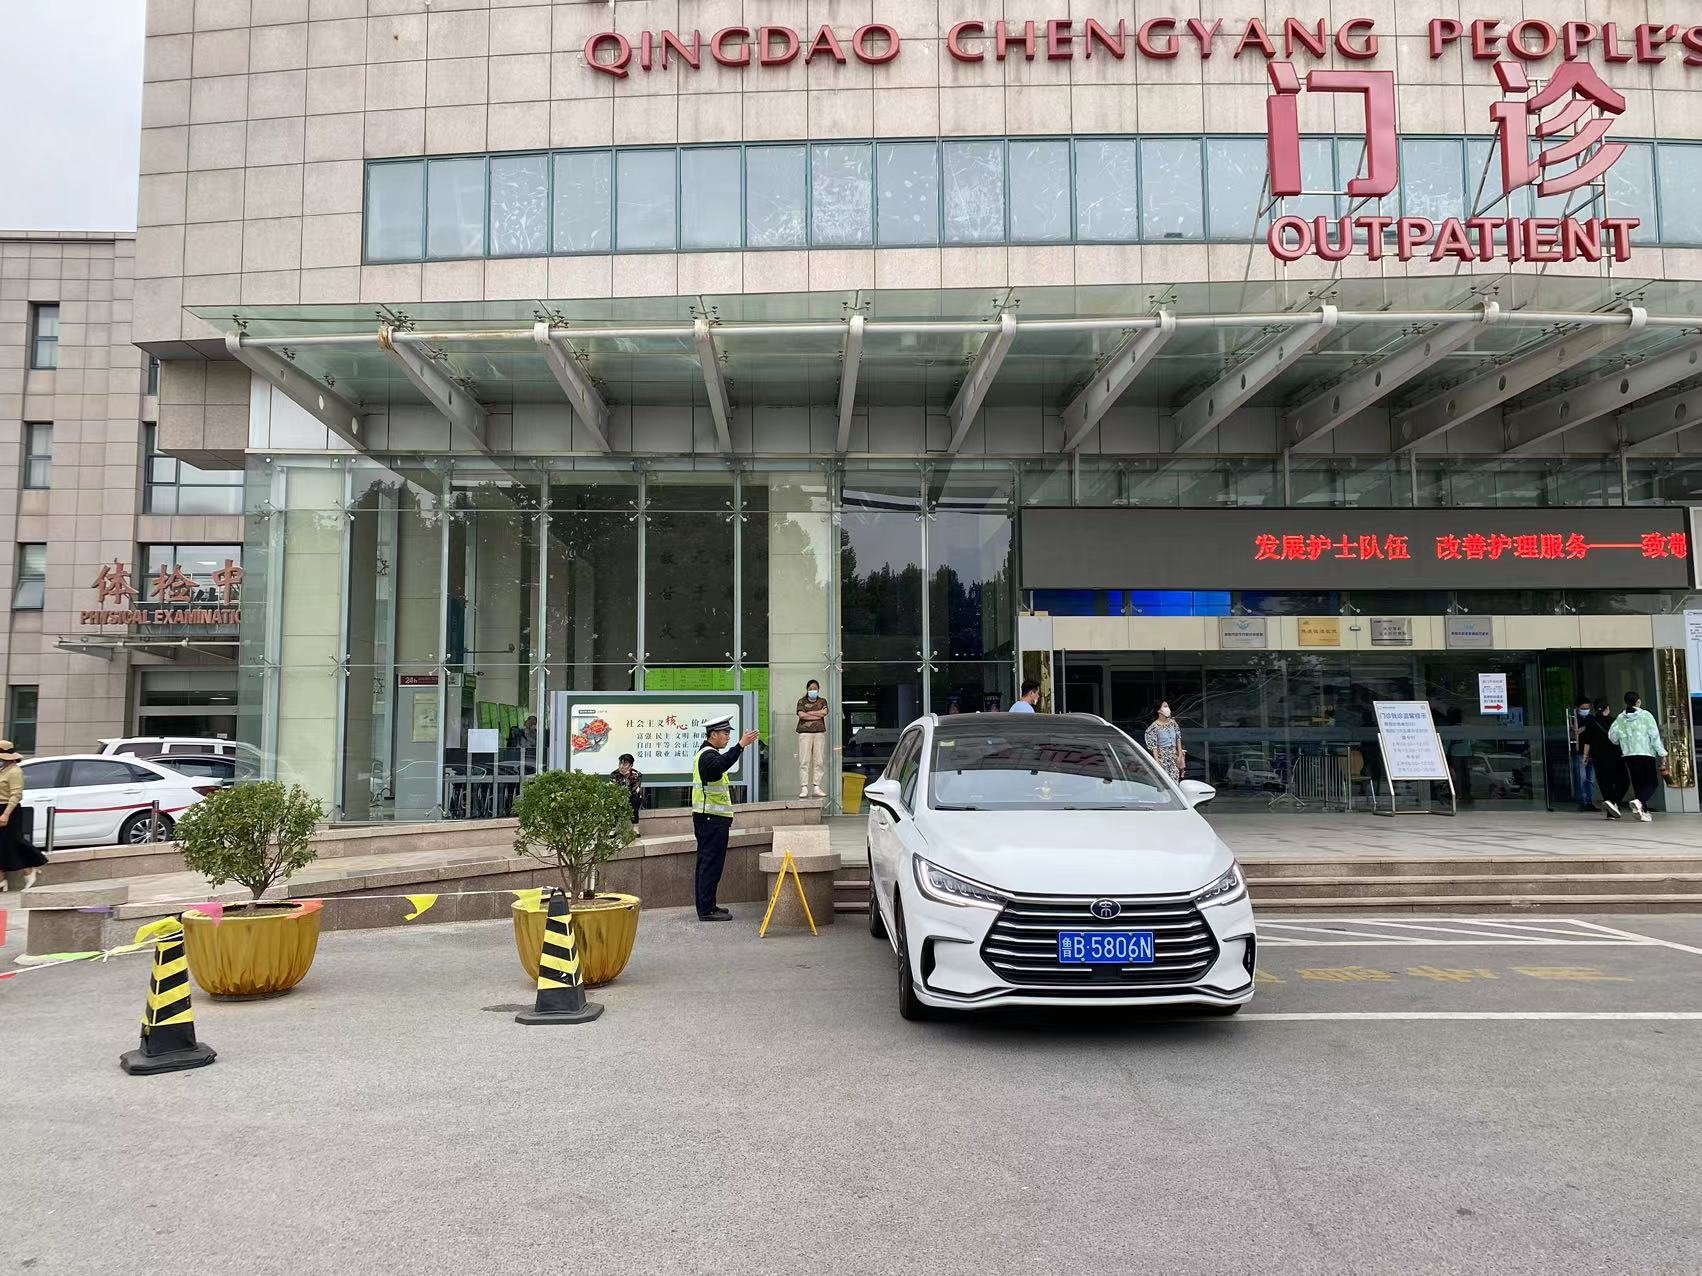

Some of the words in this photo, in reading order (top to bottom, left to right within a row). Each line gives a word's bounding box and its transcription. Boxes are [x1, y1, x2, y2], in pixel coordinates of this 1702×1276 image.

[584, 23, 900, 78] QINGDAO
[948, 18, 1378, 61] CHENGYANG
[1428, 18, 1702, 66] PEOPLE'S
[1267, 61, 1627, 197] 门诊
[1268, 216, 1640, 262] OUTPATIENT
[1255, 534, 1411, 560] 发展护士队伍
[91, 559, 244, 606] 体检中
[80, 609, 151, 625] PHYSICAL
